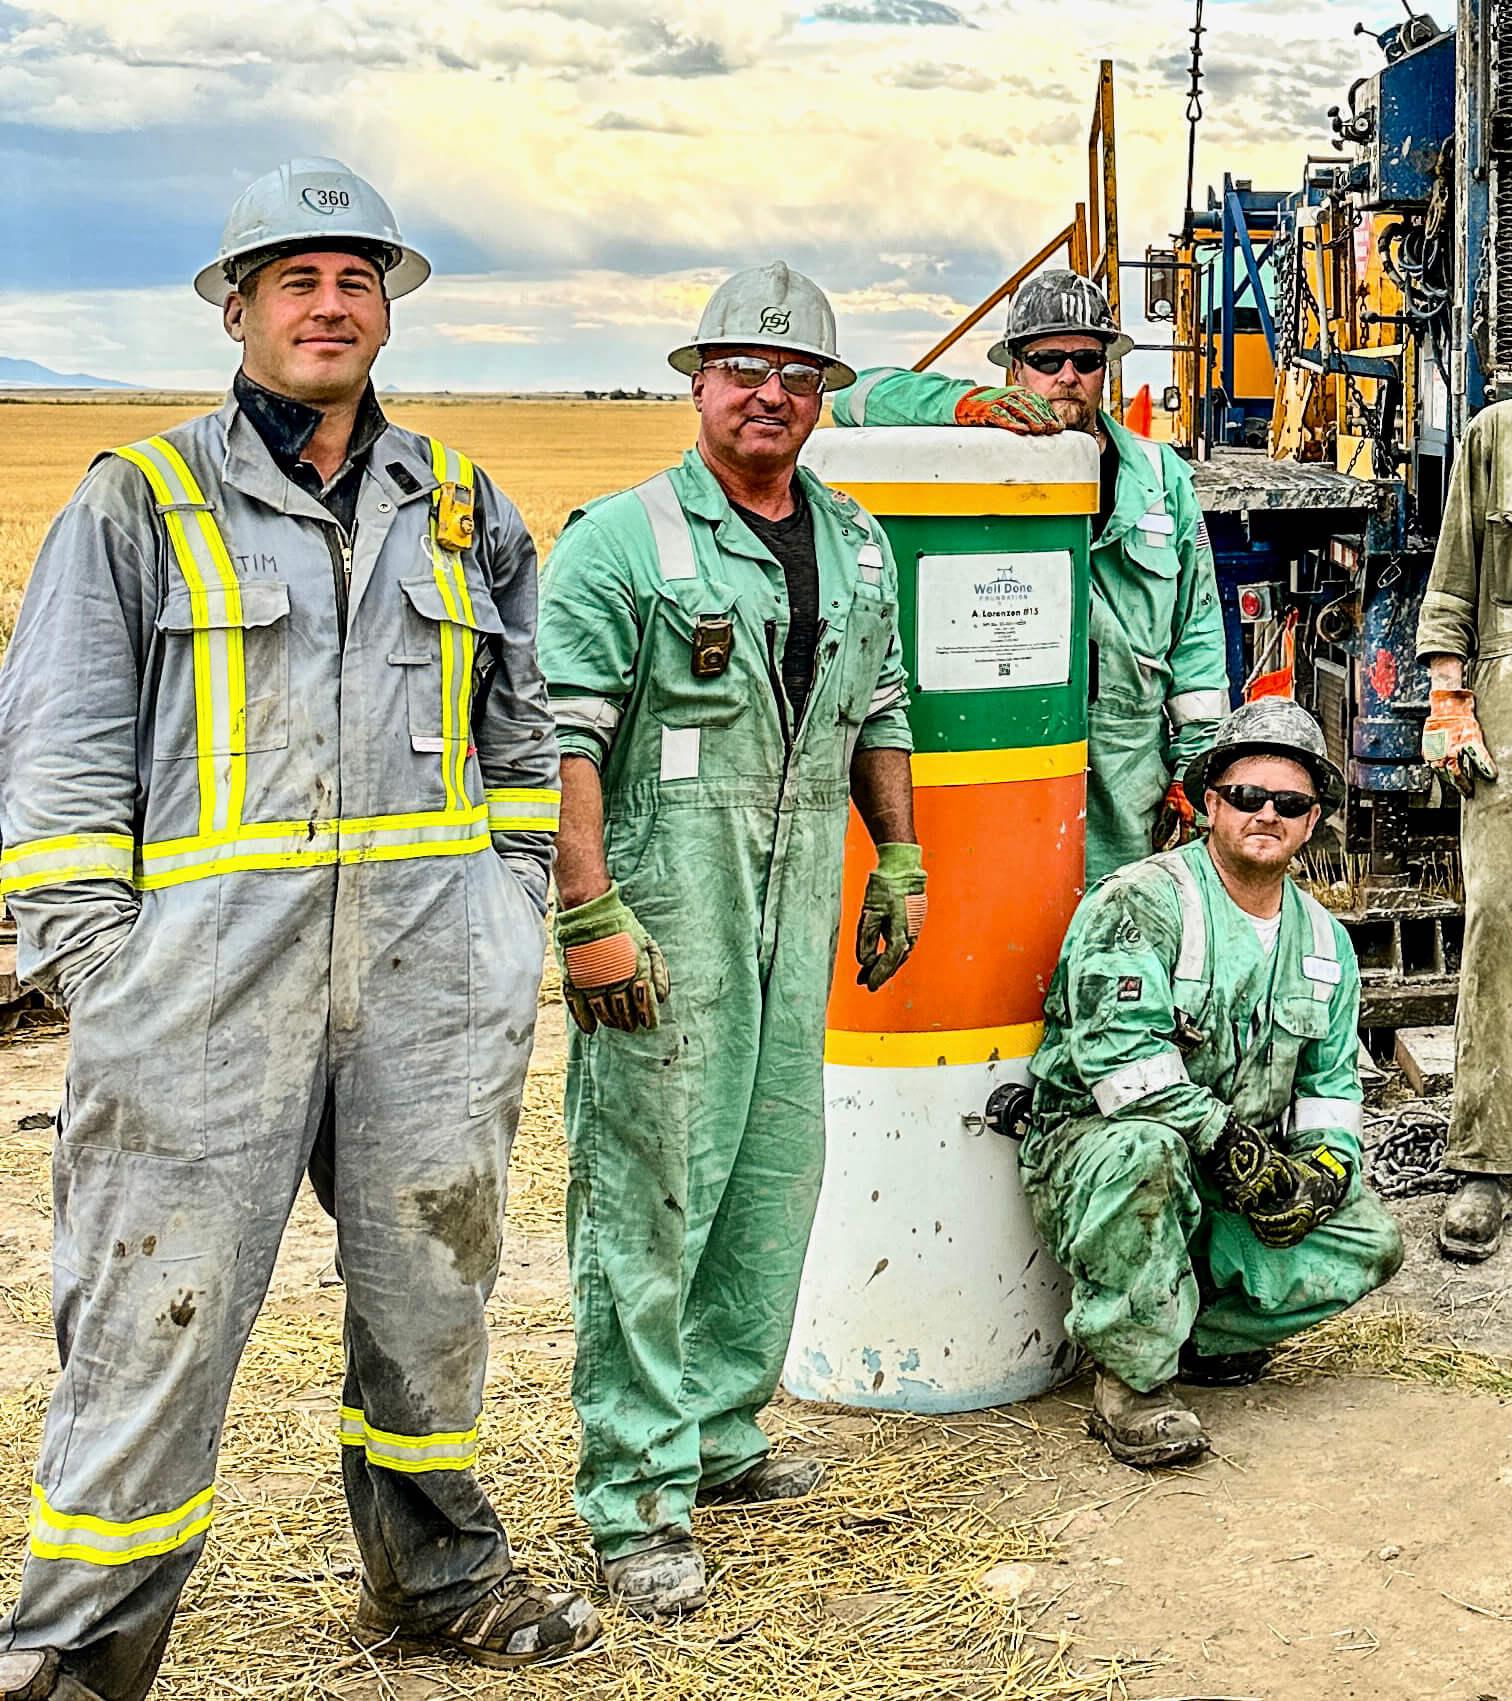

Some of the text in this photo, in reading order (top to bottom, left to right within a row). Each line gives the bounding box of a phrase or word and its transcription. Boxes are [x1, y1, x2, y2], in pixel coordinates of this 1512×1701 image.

[317, 190, 350, 206] 360
[236, 553, 278, 573] TIM
[974, 583, 1033, 594] Well Done
[982, 610, 1021, 618] Lorenzen
